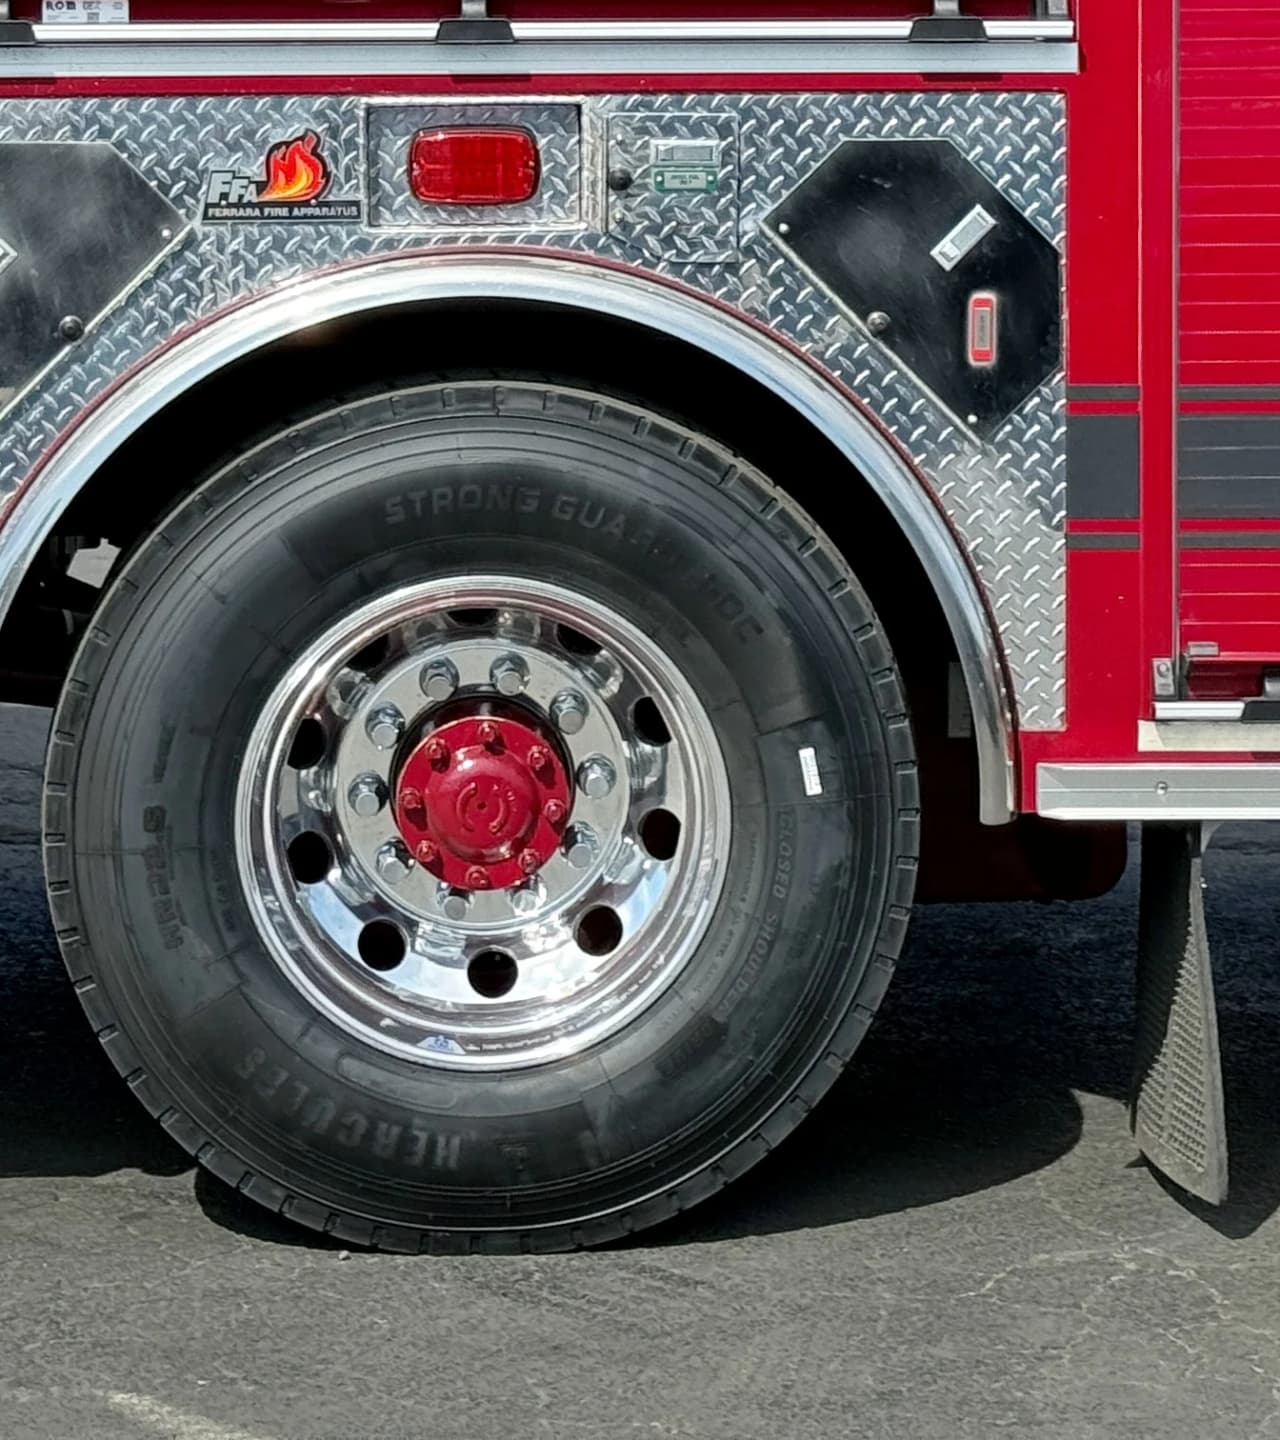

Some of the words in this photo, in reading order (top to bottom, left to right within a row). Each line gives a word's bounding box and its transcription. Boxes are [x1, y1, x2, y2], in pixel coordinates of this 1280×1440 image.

[46, 1, 77, 11] ROM
[207, 172, 258, 203] FFA
[208, 208, 261, 217] FERRARA
[263, 208, 290, 217] FIRE
[291, 207, 358, 216] APPARATUS
[385, 484, 542, 524] STRONG
[233, 1046, 463, 1171] HERCULES
